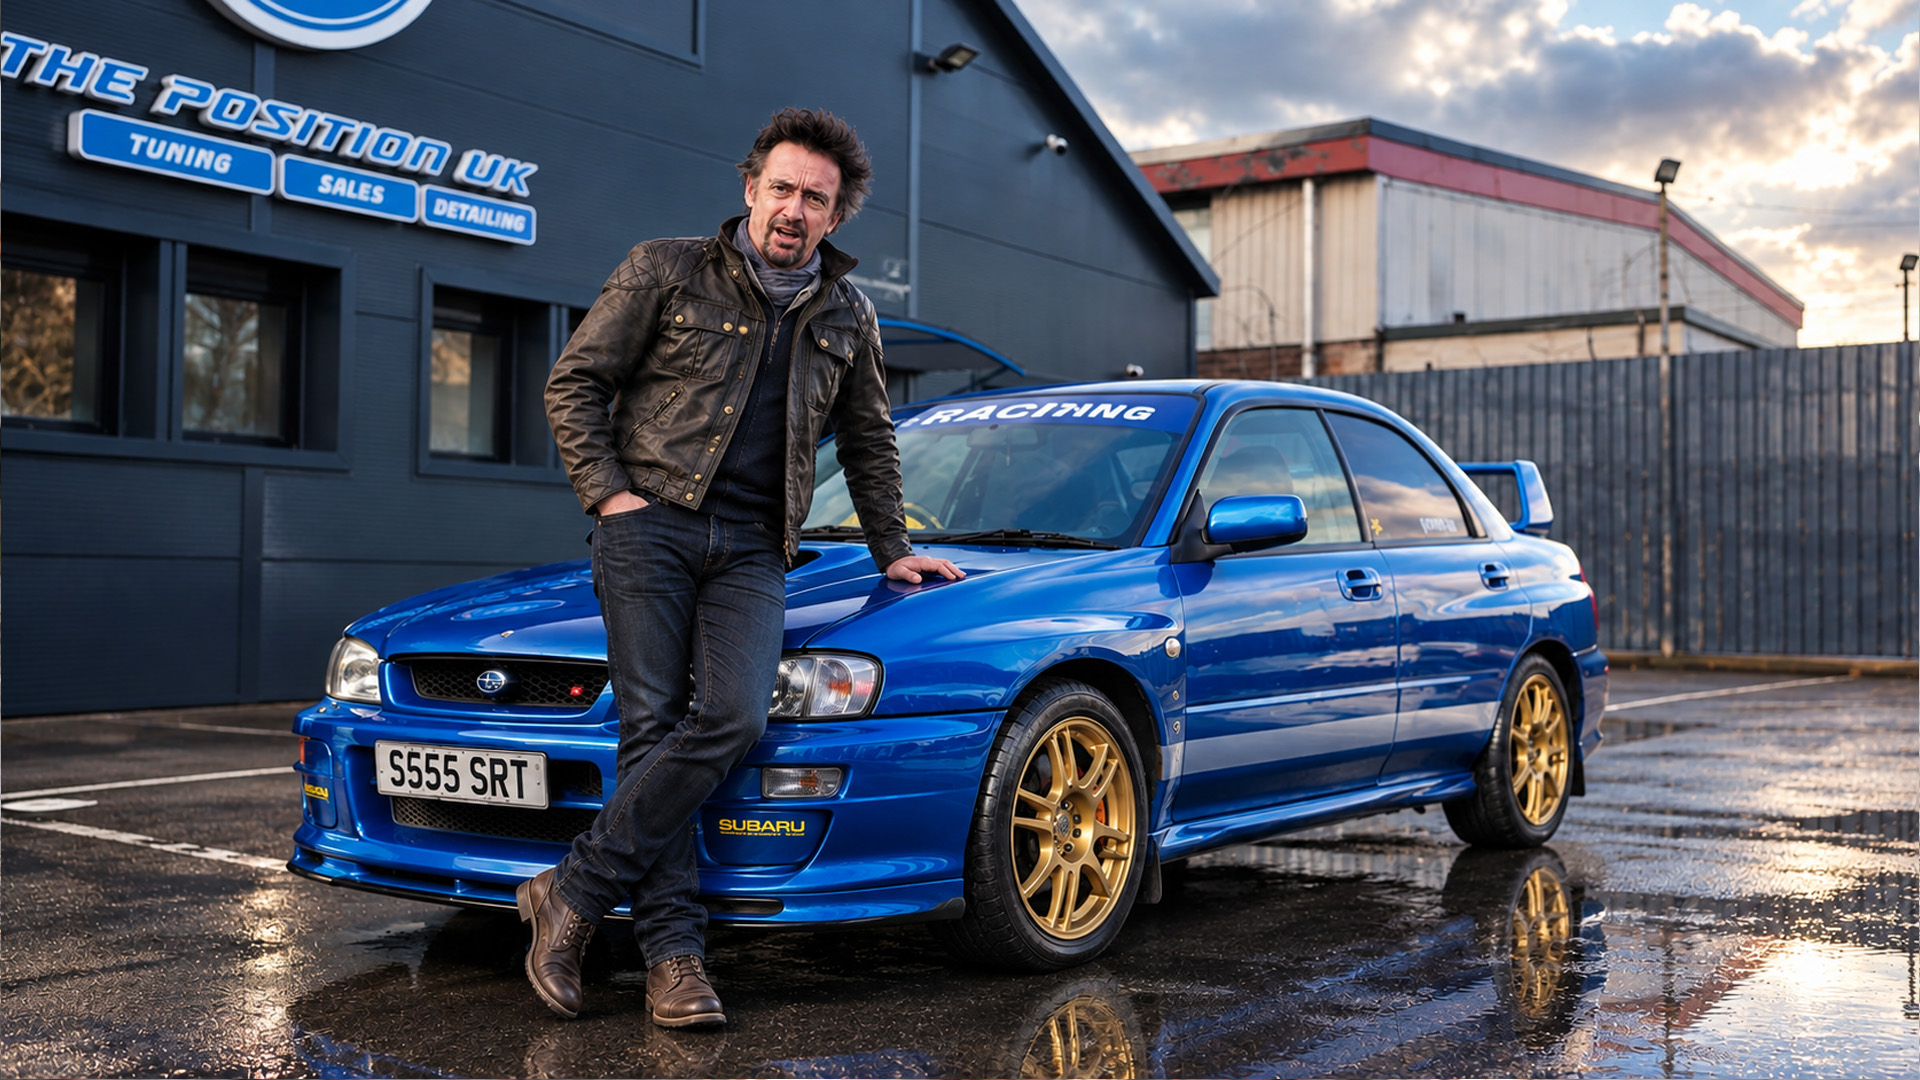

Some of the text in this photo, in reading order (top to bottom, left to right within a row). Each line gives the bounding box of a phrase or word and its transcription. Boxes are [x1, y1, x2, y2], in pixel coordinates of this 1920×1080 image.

[1, 31, 149, 105] THE
[454, 149, 539, 198] UK
[129, 132, 233, 175] TUNING
[317, 173, 386, 205] SALES
[432, 197, 527, 233] DETAILING
[389, 749, 528, 799] S555 SRT
[718, 818, 805, 833] SUBARU
